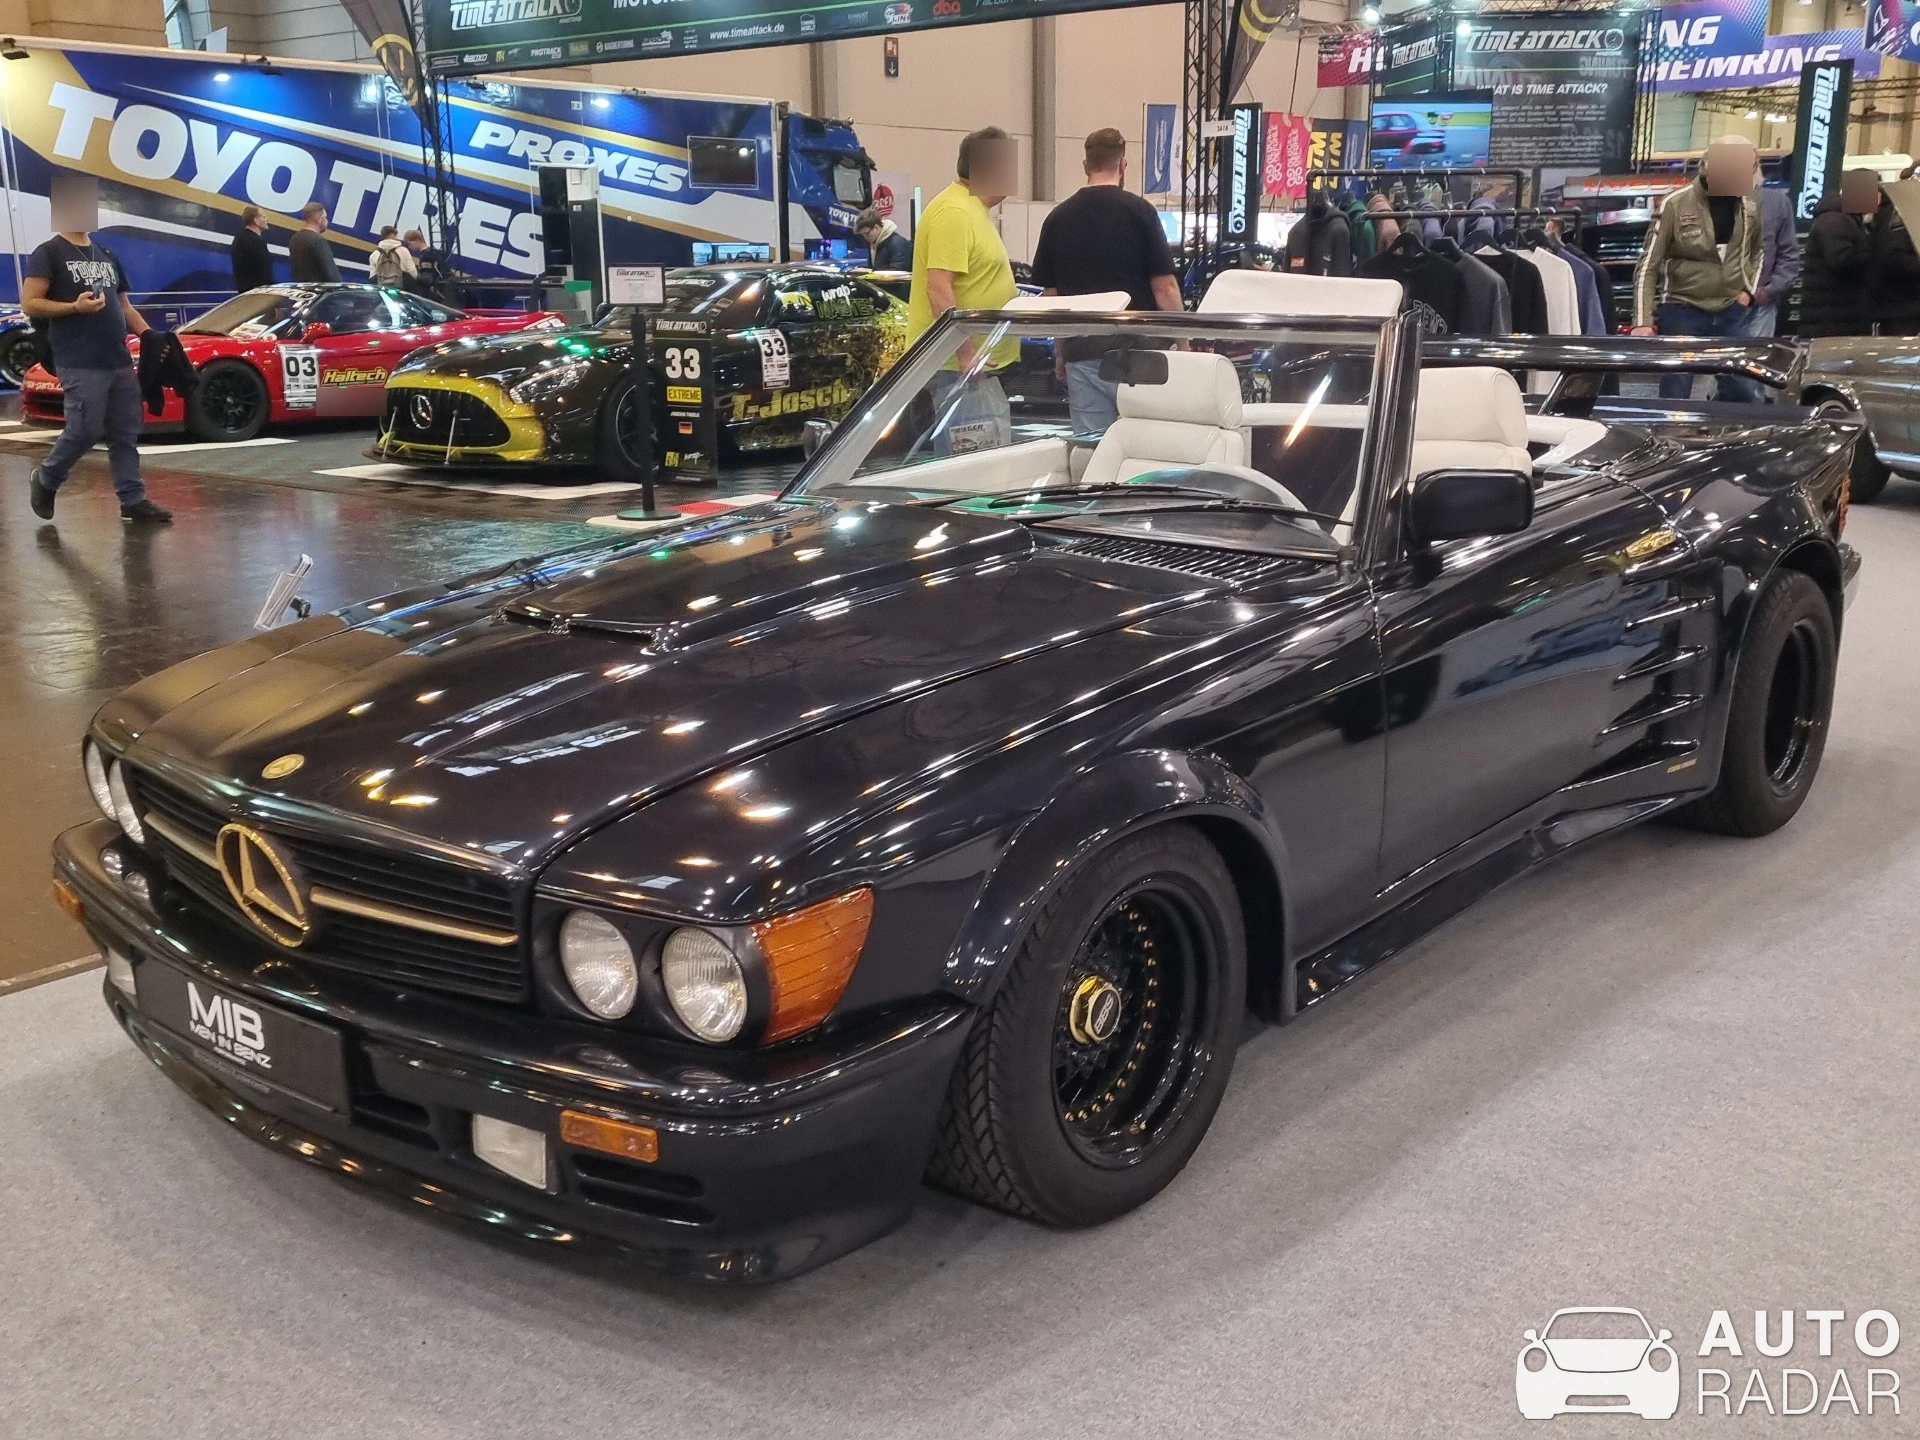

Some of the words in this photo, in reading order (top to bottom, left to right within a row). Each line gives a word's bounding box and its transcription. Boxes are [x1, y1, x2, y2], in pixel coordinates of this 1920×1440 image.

[710, 23, 785, 40] www.timeattack.de
[1519, 30, 1605, 50] ATTACK
[1511, 84, 1524, 95] IS
[1526, 83, 1554, 95] TIME
[1556, 82, 1609, 94] ATTACK?
[48, 81, 317, 213] TOYO
[468, 119, 688, 192] PROXES
[66, 261, 117, 285] TOMMY
[84, 278, 111, 288] JES
[762, 337, 786, 357] 33
[285, 356, 316, 377] 03
[665, 348, 700, 379] 33
[323, 368, 386, 384] Haltech
[668, 388, 701, 401] EXTREME
[731, 377, 851, 421] T-Josch
[187, 982, 265, 1050] MIB
[1094, 993, 1114, 1034] BBS
